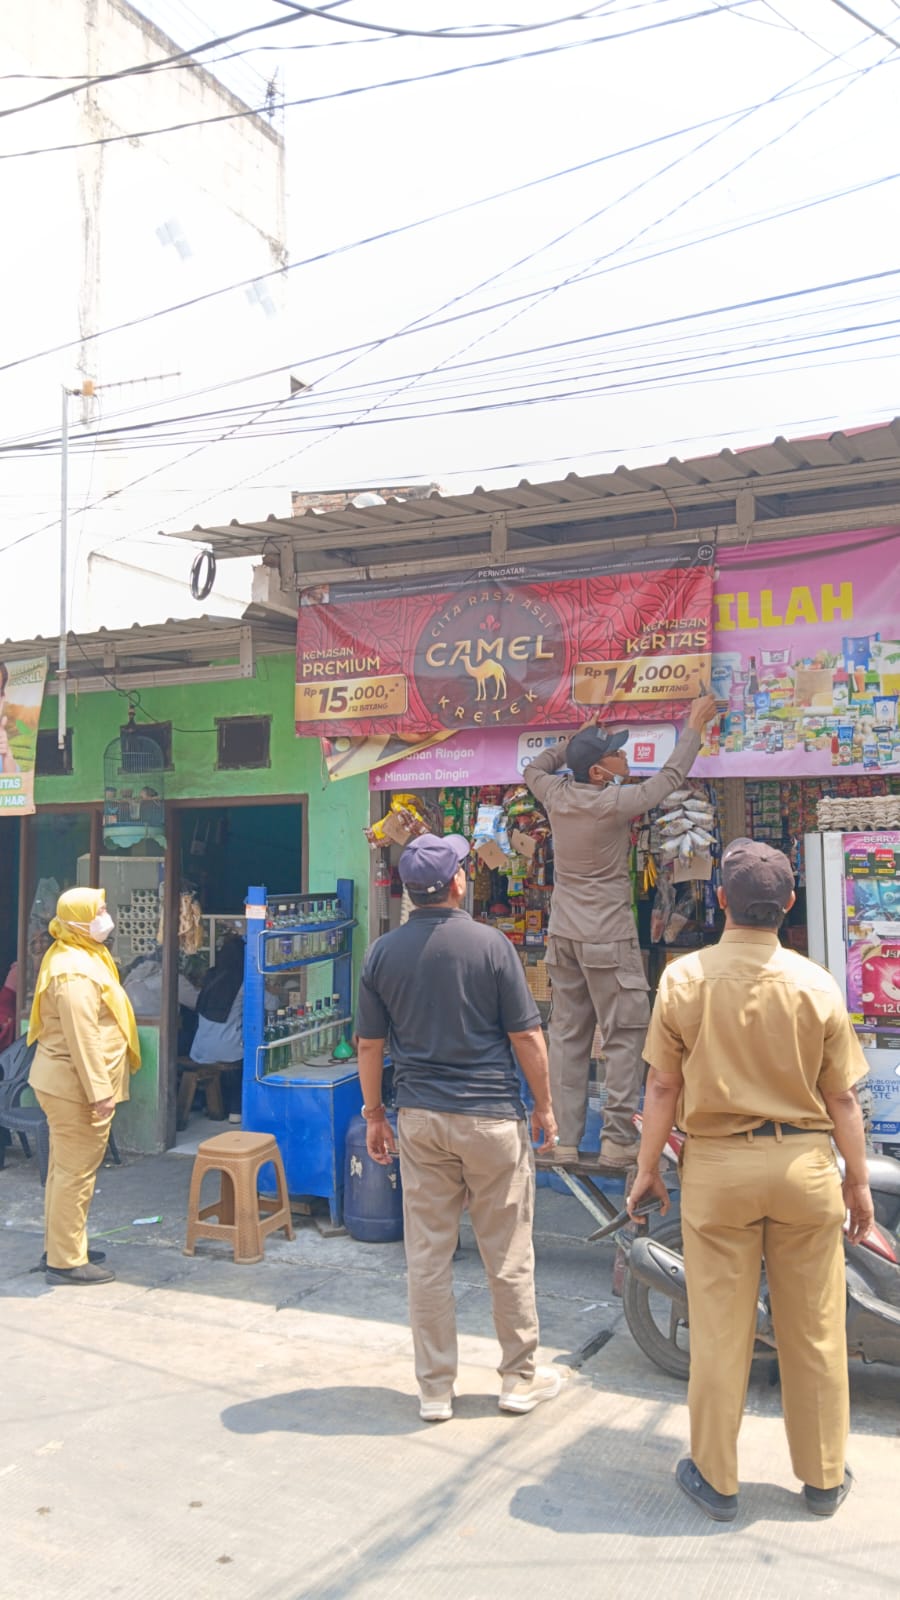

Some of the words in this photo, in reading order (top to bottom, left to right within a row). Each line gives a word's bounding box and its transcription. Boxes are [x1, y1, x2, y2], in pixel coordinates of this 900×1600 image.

[431, 605, 461, 638] CITA
[468, 592, 515, 606] RASA
[521, 599, 553, 629] ASLI
[642, 617, 708, 633] KEMASAN
[425, 635, 555, 667] CAMEL
[626, 631, 708, 653] KERTAS
[302, 647, 354, 661] KEMASAN
[302, 656, 380, 678] PREMIUM
[651, 684, 689, 693] BATANG
[438, 690, 538, 722] KRETEK
[435, 748, 475, 761] Ringan
[384, 771, 432, 783] Minuman
[435, 768, 469, 782] Dingin
